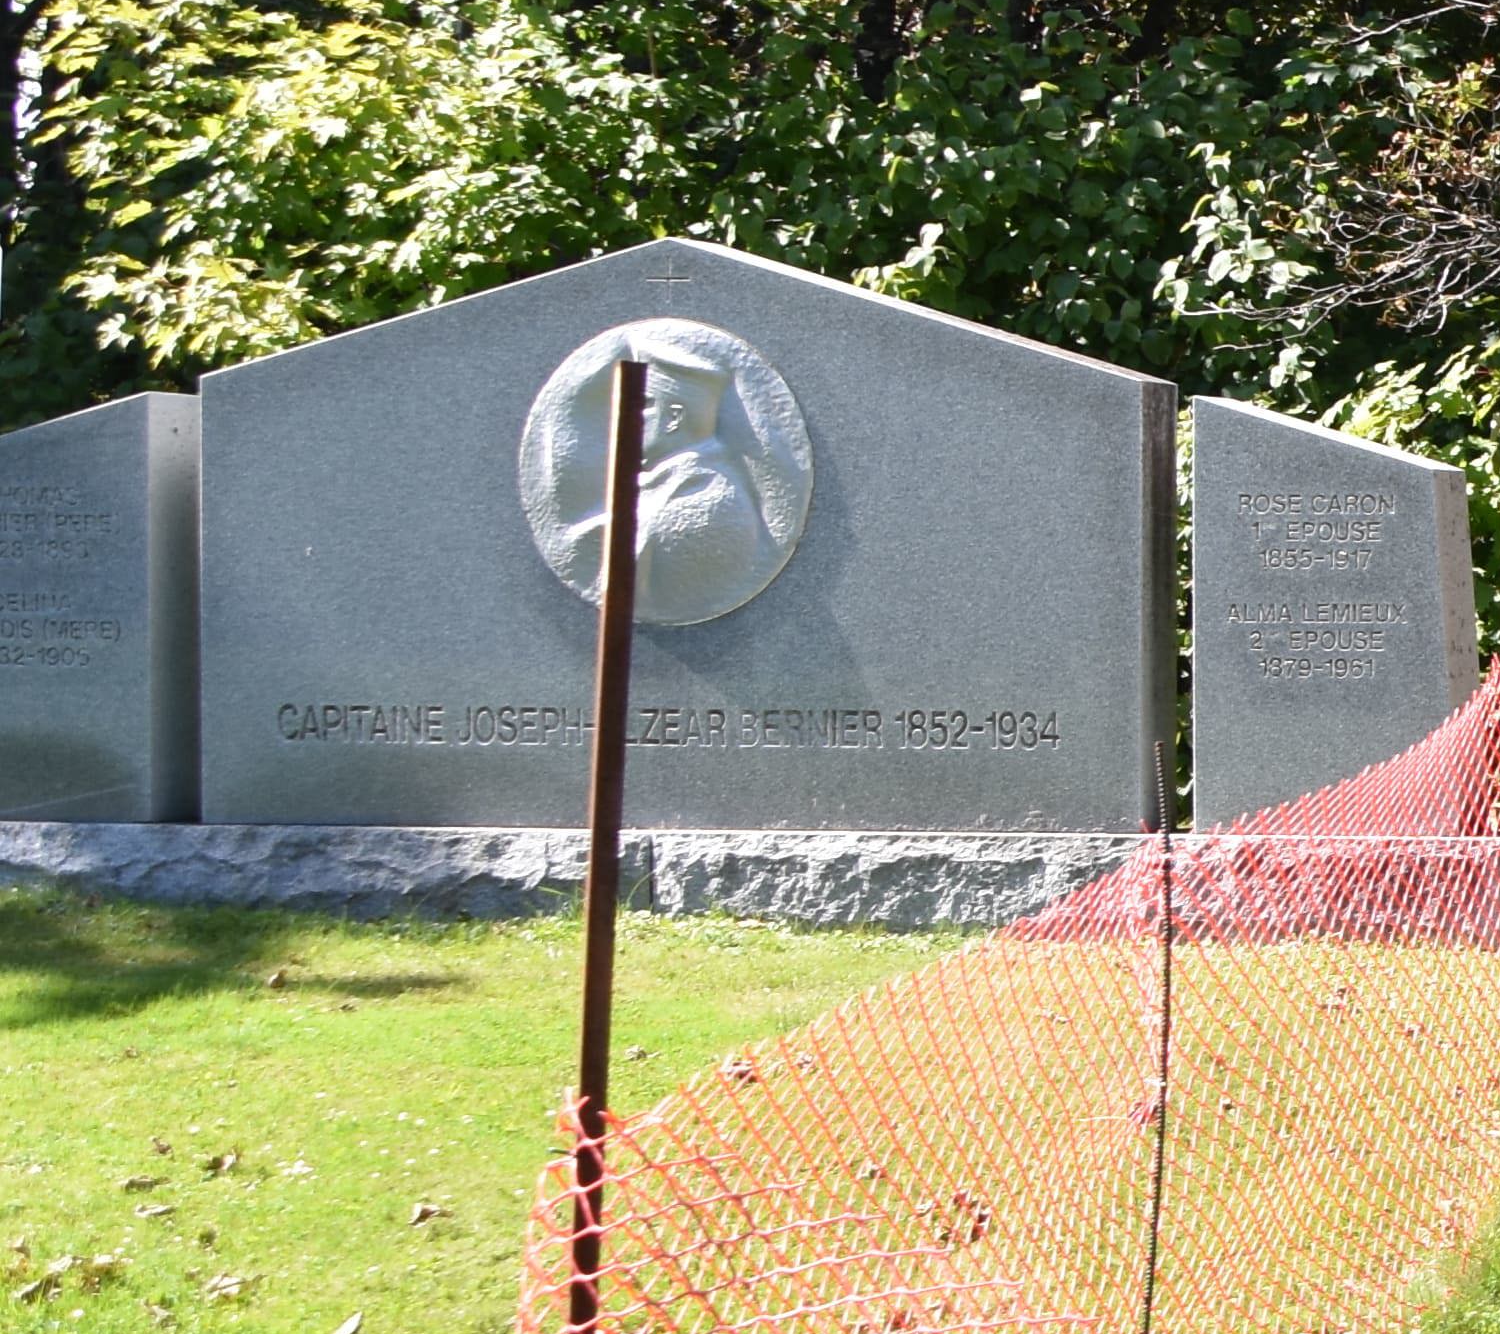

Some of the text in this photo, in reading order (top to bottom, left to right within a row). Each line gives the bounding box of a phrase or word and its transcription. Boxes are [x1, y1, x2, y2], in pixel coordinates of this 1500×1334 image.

[1238, 492, 1395, 515] ROSE CARON
[1286, 520, 1383, 543] EPOUSE
[1259, 548, 1373, 570] 1855-1917
[1227, 602, 1408, 624] ALMA LEMIEUX
[1289, 630, 1385, 652] EPOUSE
[1258, 657, 1376, 680] 1879-1961
[277, 702, 447, 746] CAPITAINE
[737, 707, 885, 749] BERNIER
[894, 709, 1062, 750] 1852-1934
